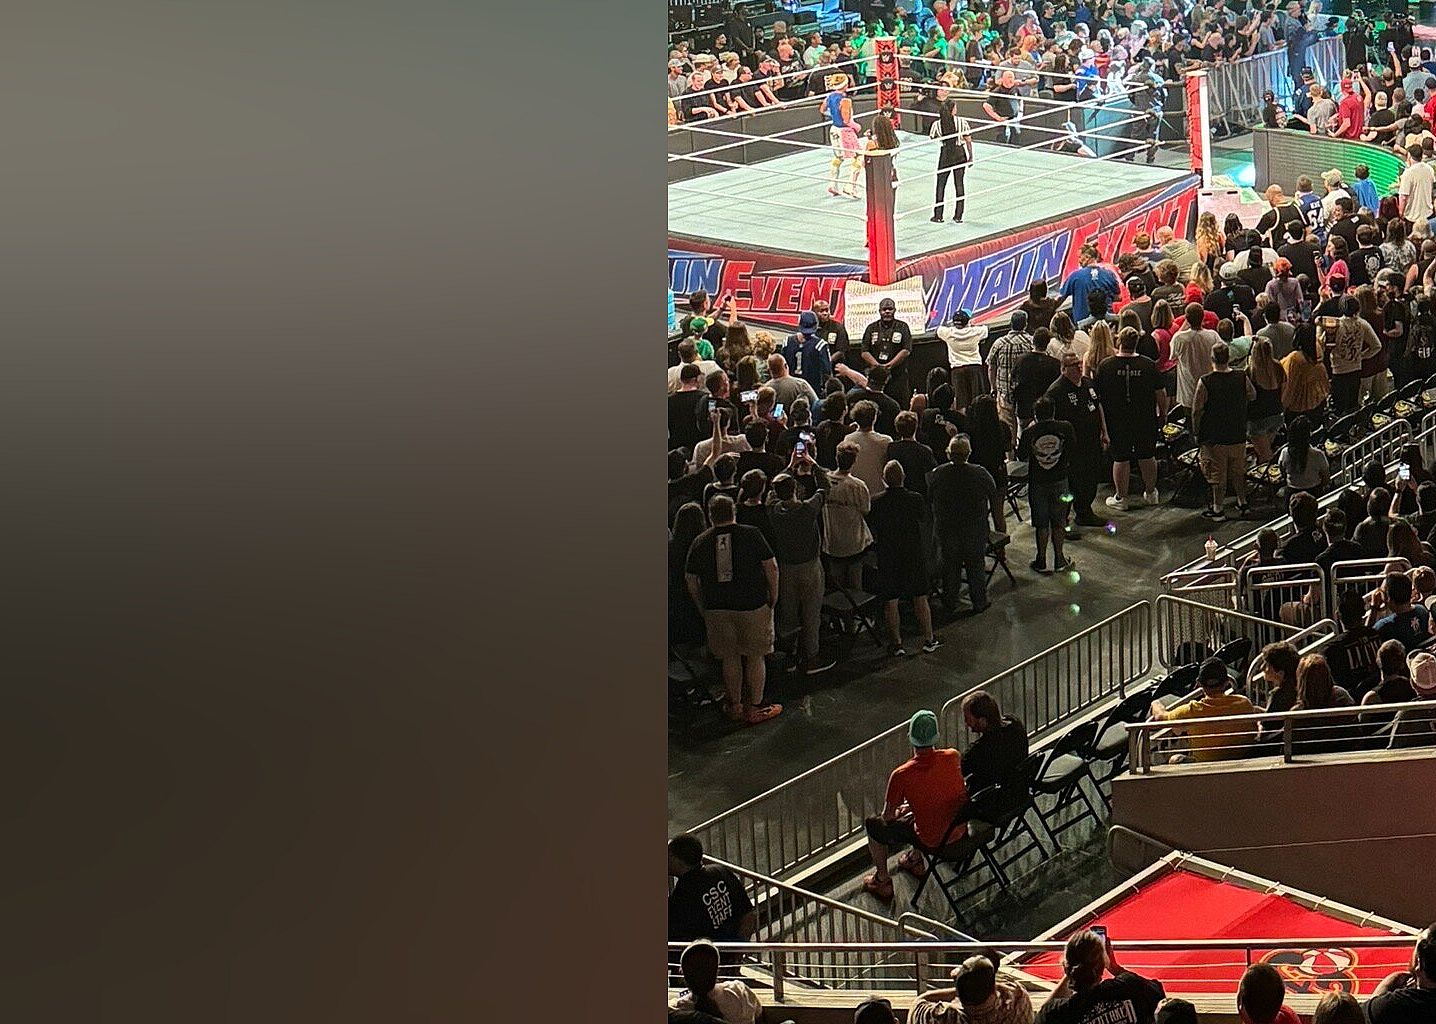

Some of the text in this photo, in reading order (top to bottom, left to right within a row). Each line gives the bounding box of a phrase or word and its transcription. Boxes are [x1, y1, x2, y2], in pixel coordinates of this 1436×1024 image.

[926, 229, 1071, 330] MAIN
[702, 880, 727, 906] CSC
[707, 891, 731, 920] EVENT
